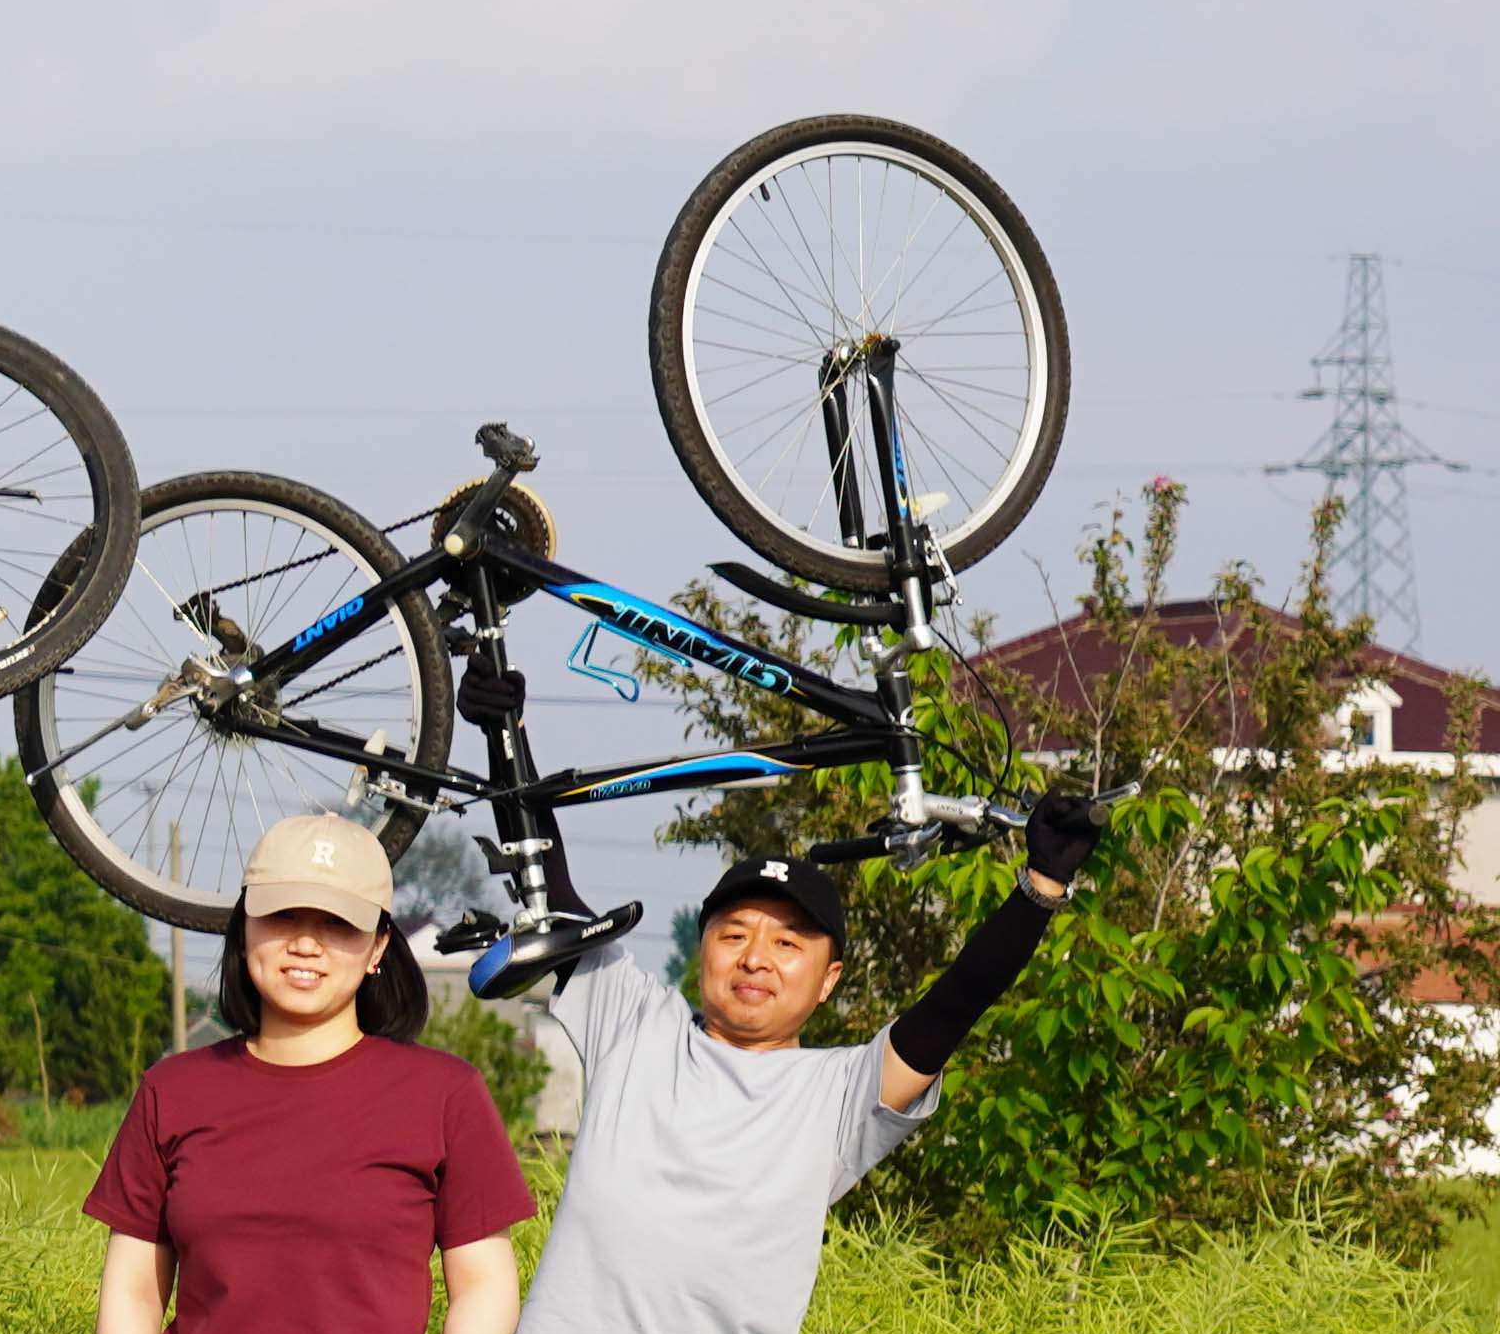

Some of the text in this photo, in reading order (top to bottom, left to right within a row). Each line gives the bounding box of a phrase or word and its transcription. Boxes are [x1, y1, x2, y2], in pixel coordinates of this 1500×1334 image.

[292, 595, 365, 654] GIANT
[616, 605, 792, 695] GIANT
[311, 841, 335, 868] R
[760, 861, 789, 883] R
